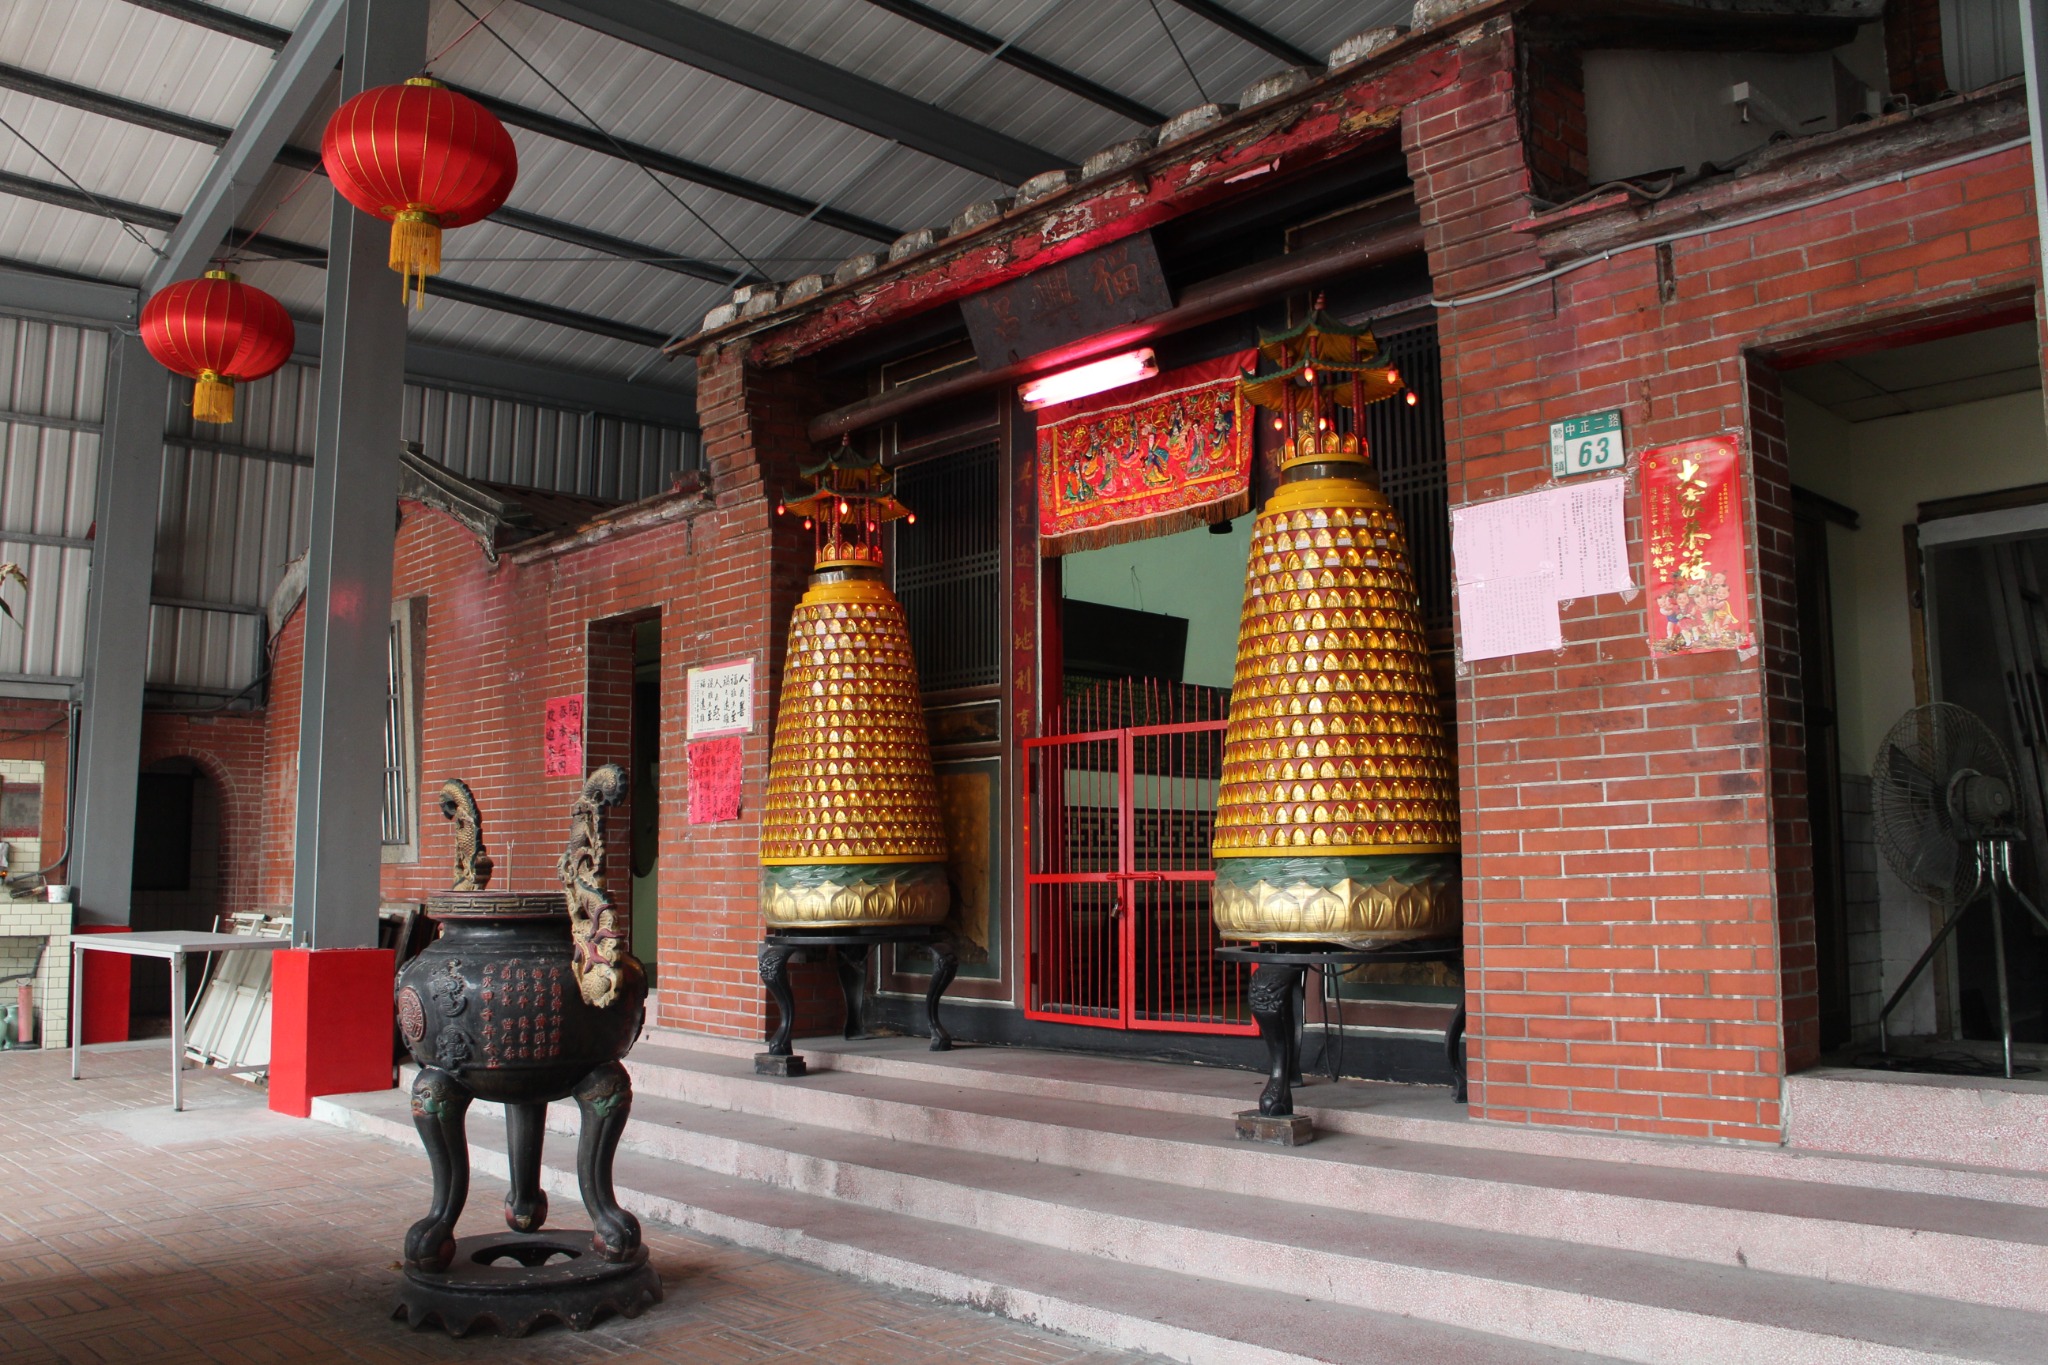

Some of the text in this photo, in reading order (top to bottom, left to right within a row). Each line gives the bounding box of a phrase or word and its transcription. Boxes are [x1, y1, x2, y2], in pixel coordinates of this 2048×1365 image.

[1565, 413, 1619, 438] 中正二路
[1579, 438, 1610, 467] 63
